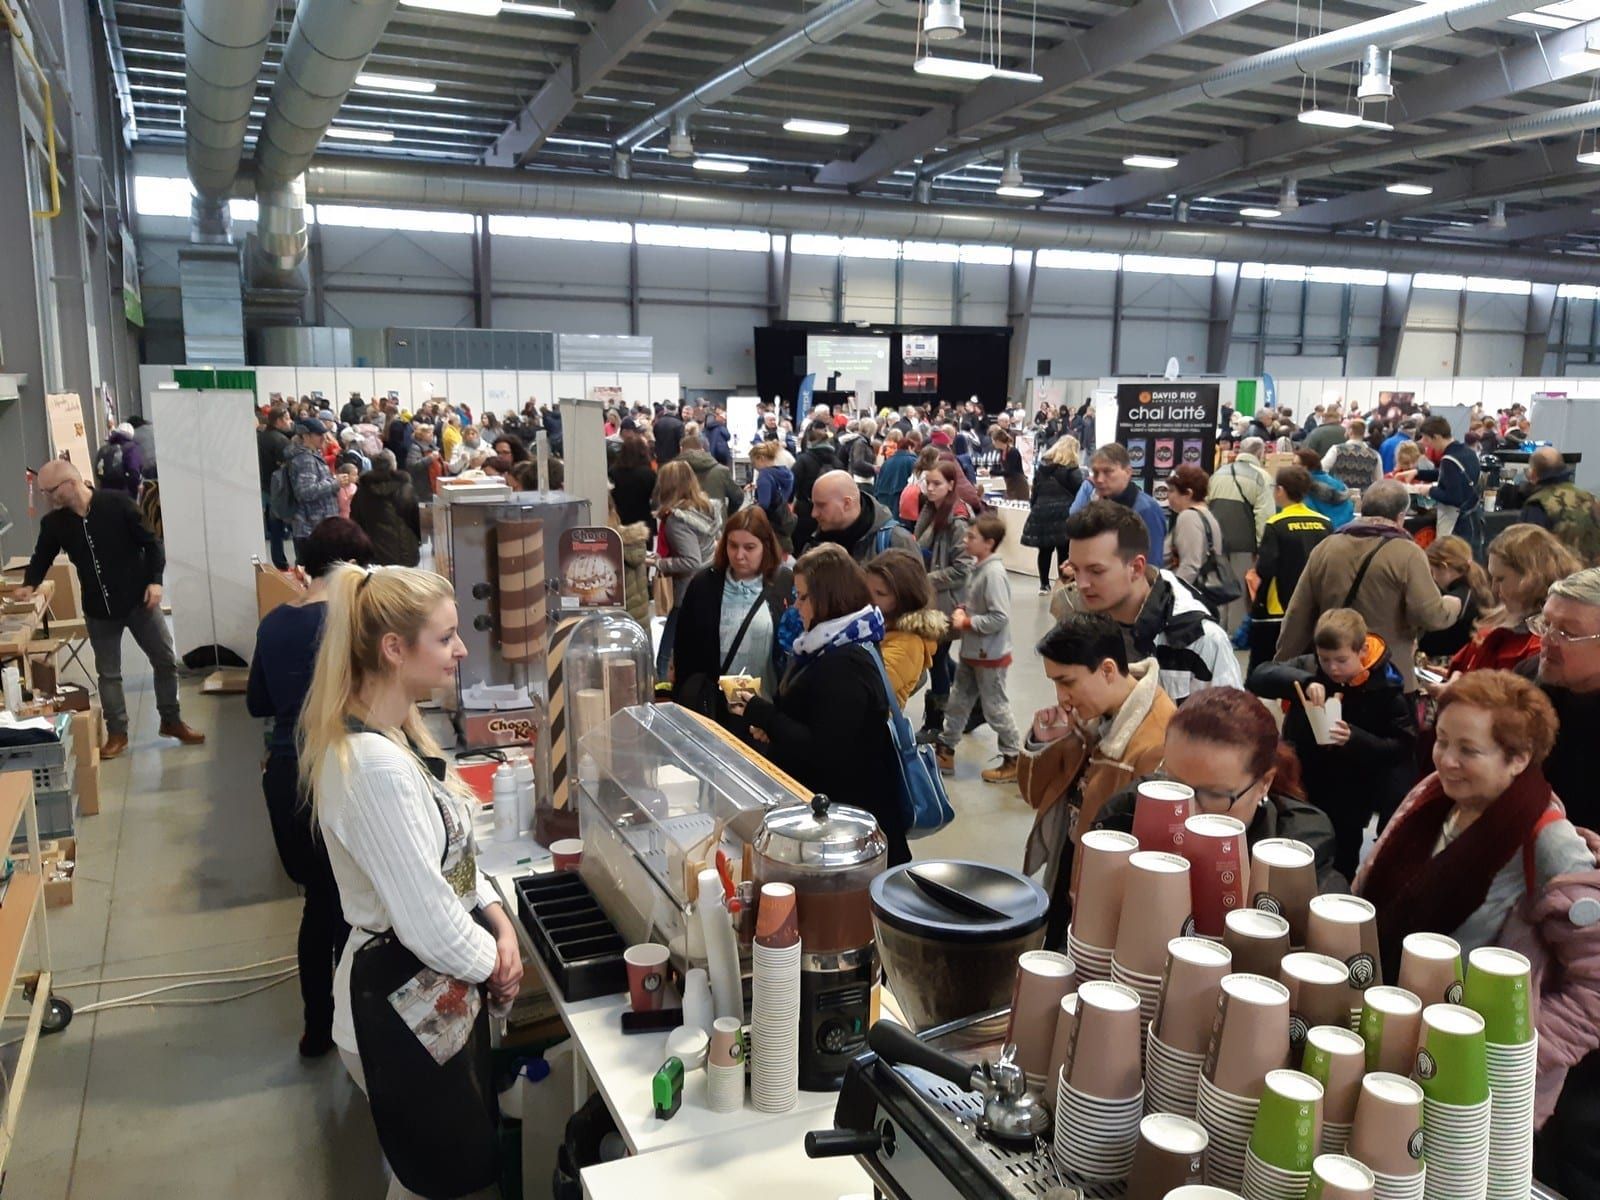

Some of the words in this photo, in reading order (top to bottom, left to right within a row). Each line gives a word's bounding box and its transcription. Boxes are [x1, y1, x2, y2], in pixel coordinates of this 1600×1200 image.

[1152, 391, 1178, 399] DAVID
[1180, 391, 1197, 399] RIO
[1128, 406, 1164, 420] chai
[1168, 405, 1206, 420] latté
[488, 719, 530, 732] Choco
